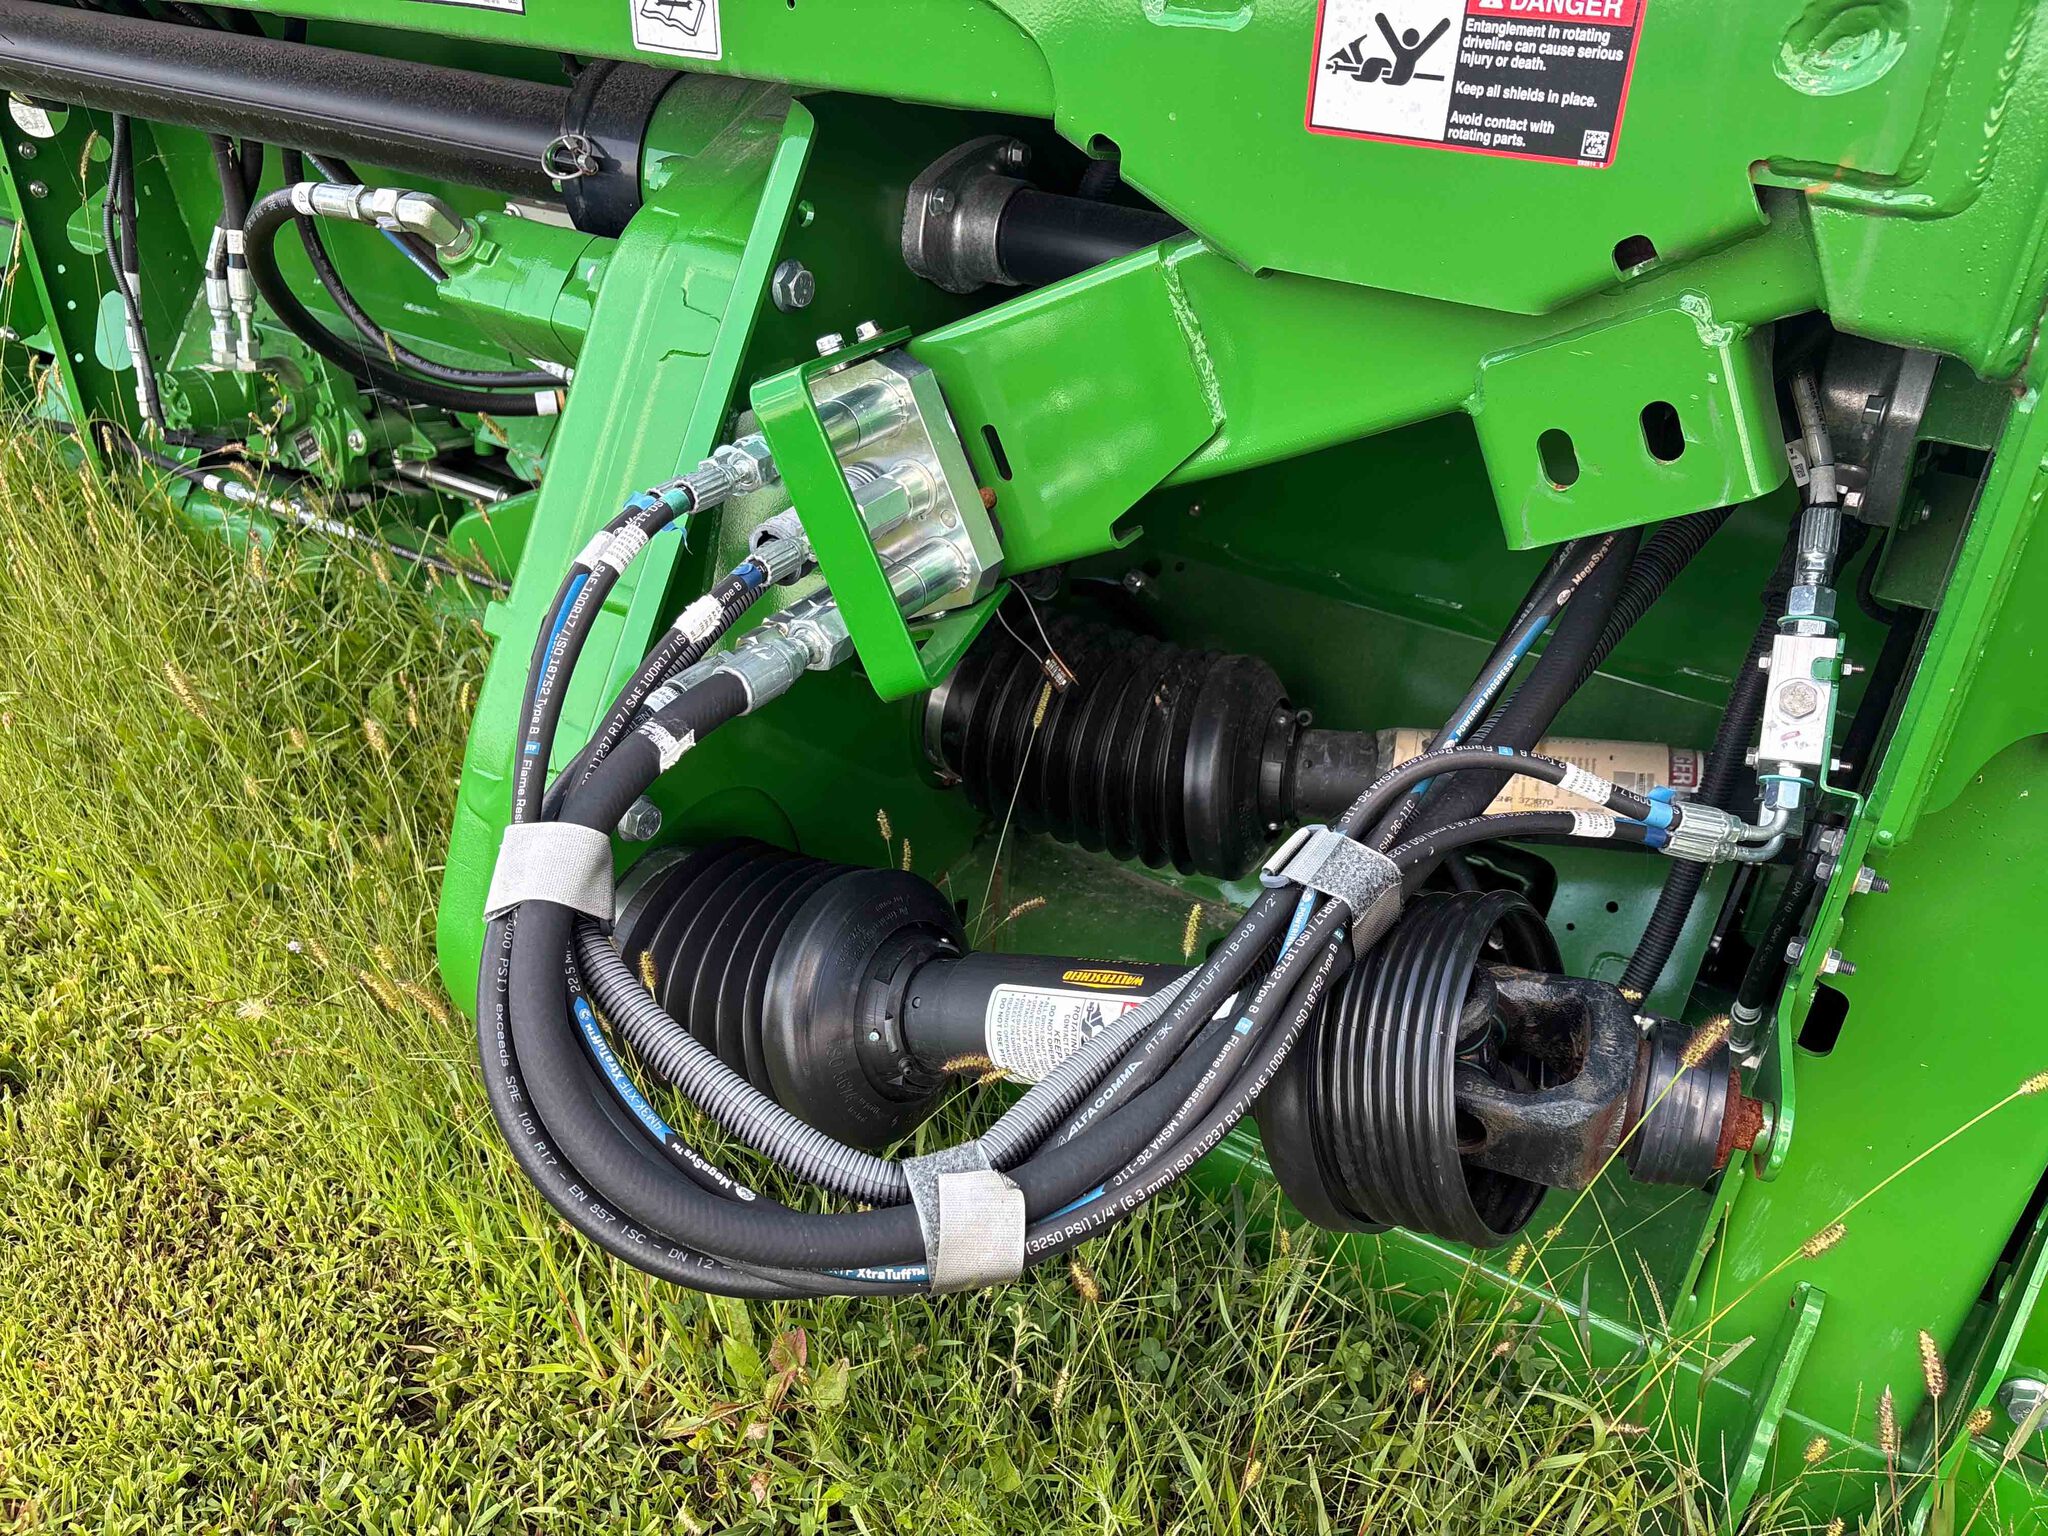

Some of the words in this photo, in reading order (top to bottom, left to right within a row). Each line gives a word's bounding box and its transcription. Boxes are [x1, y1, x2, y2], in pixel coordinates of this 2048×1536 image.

[1509, 0, 1625, 18] DANGER
[1465, 18, 1546, 39] Entanglement
[1549, 24, 1560, 39] in
[1562, 27, 1610, 46] rotating
[1460, 50, 1493, 69] injury
[1496, 55, 1508, 67] or
[1511, 55, 1546, 71] death.
[1463, 35, 1512, 53] driveline
[1514, 41, 1536, 54] can
[1539, 44, 1575, 57] cause
[1577, 46, 1624, 61] serious
[1455, 81, 1484, 99] Keep
[1486, 85, 1501, 98] all
[1503, 86, 1545, 103] shields
[1548, 90, 1559, 103] in
[1561, 92, 1598, 108] place.
[1450, 111, 1482, 127] Avoid
[1485, 117, 1527, 131] contact
[1530, 120, 1555, 134] with
[1448, 127, 1491, 146] rotating
[1493, 134, 1526, 147] parts.
[590, 565, 606, 585] SAE
[567, 586, 592, 627] 100R17
[719, 588, 735, 606] ype
[733, 581, 743, 591] B
[554, 637, 568, 656] ISO
[540, 657, 560, 695] 18752
[531, 698, 548, 724] Type
[590, 736, 612, 770] 11237
[608, 713, 625, 736] R17
[626, 686, 645, 709] SAE
[640, 649, 672, 687] 100R17
[1455, 698, 1486, 737] POWERING
[517, 759, 533, 796] Flame
[1370, 766, 1401, 787] MSHA
[1341, 789, 1373, 824] 2G-11C
[1391, 800, 1416, 833] 2G-11C
[1295, 931, 1312, 947] ISO
[497, 957, 510, 993] PSI)
[1275, 948, 1299, 980] 18752
[565, 966, 581, 993] 22.5
[1062, 970, 1145, 987] WALTERSCHEID
[999, 997, 1005, 1009] DO
[1255, 980, 1277, 1004] Type
[1048, 1005, 1055, 1016] DO
[1249, 1006, 1259, 1014] B
[495, 1003, 510, 1067] exceeds
[996, 1030, 1004, 1046] USE
[1053, 1030, 1061, 1058] KEEP
[998, 1048, 1008, 1062] PTO
[1213, 1034, 1240, 1067] Flame
[506, 1076, 522, 1103] SAE
[1067, 1060, 1143, 1142] ALFAGOMMA
[1145, 1022, 1174, 1055] AT3K
[1179, 1070, 1216, 1117] Resistant
[620, 1080, 663, 1131] 4M3K-XTF
[1025, 1229, 1064, 1256] (3250
[1065, 1216, 1092, 1238] PSI)
[1094, 1203, 1118, 1225] 1/4"
[1119, 1188, 1146, 1212] (6.3
[1147, 1169, 1175, 1197] mm)
[1174, 1154, 1194, 1174] ISO
[1193, 1123, 1227, 1160] 11237
[1224, 1101, 1246, 1127] R17
[1249, 1074, 1269, 1099] SAE
[1264, 1033, 1295, 1078] 100R17
[1294, 1008, 1309, 1030] ISO
[1307, 973, 1325, 1009] 18752
[1318, 953, 1335, 977] Type
[1331, 942, 1339, 953] B
[518, 1111, 536, 1136] 100
[1149, 1119, 1180, 1150] MSHA
[534, 1141, 557, 1166] R17
[1112, 1147, 1153, 1186] 2G-11C
[568, 1184, 588, 1202] EN
[590, 1203, 616, 1224] 857
[668, 1247, 688, 1263] DN
[696, 1256, 714, 1270] 12
